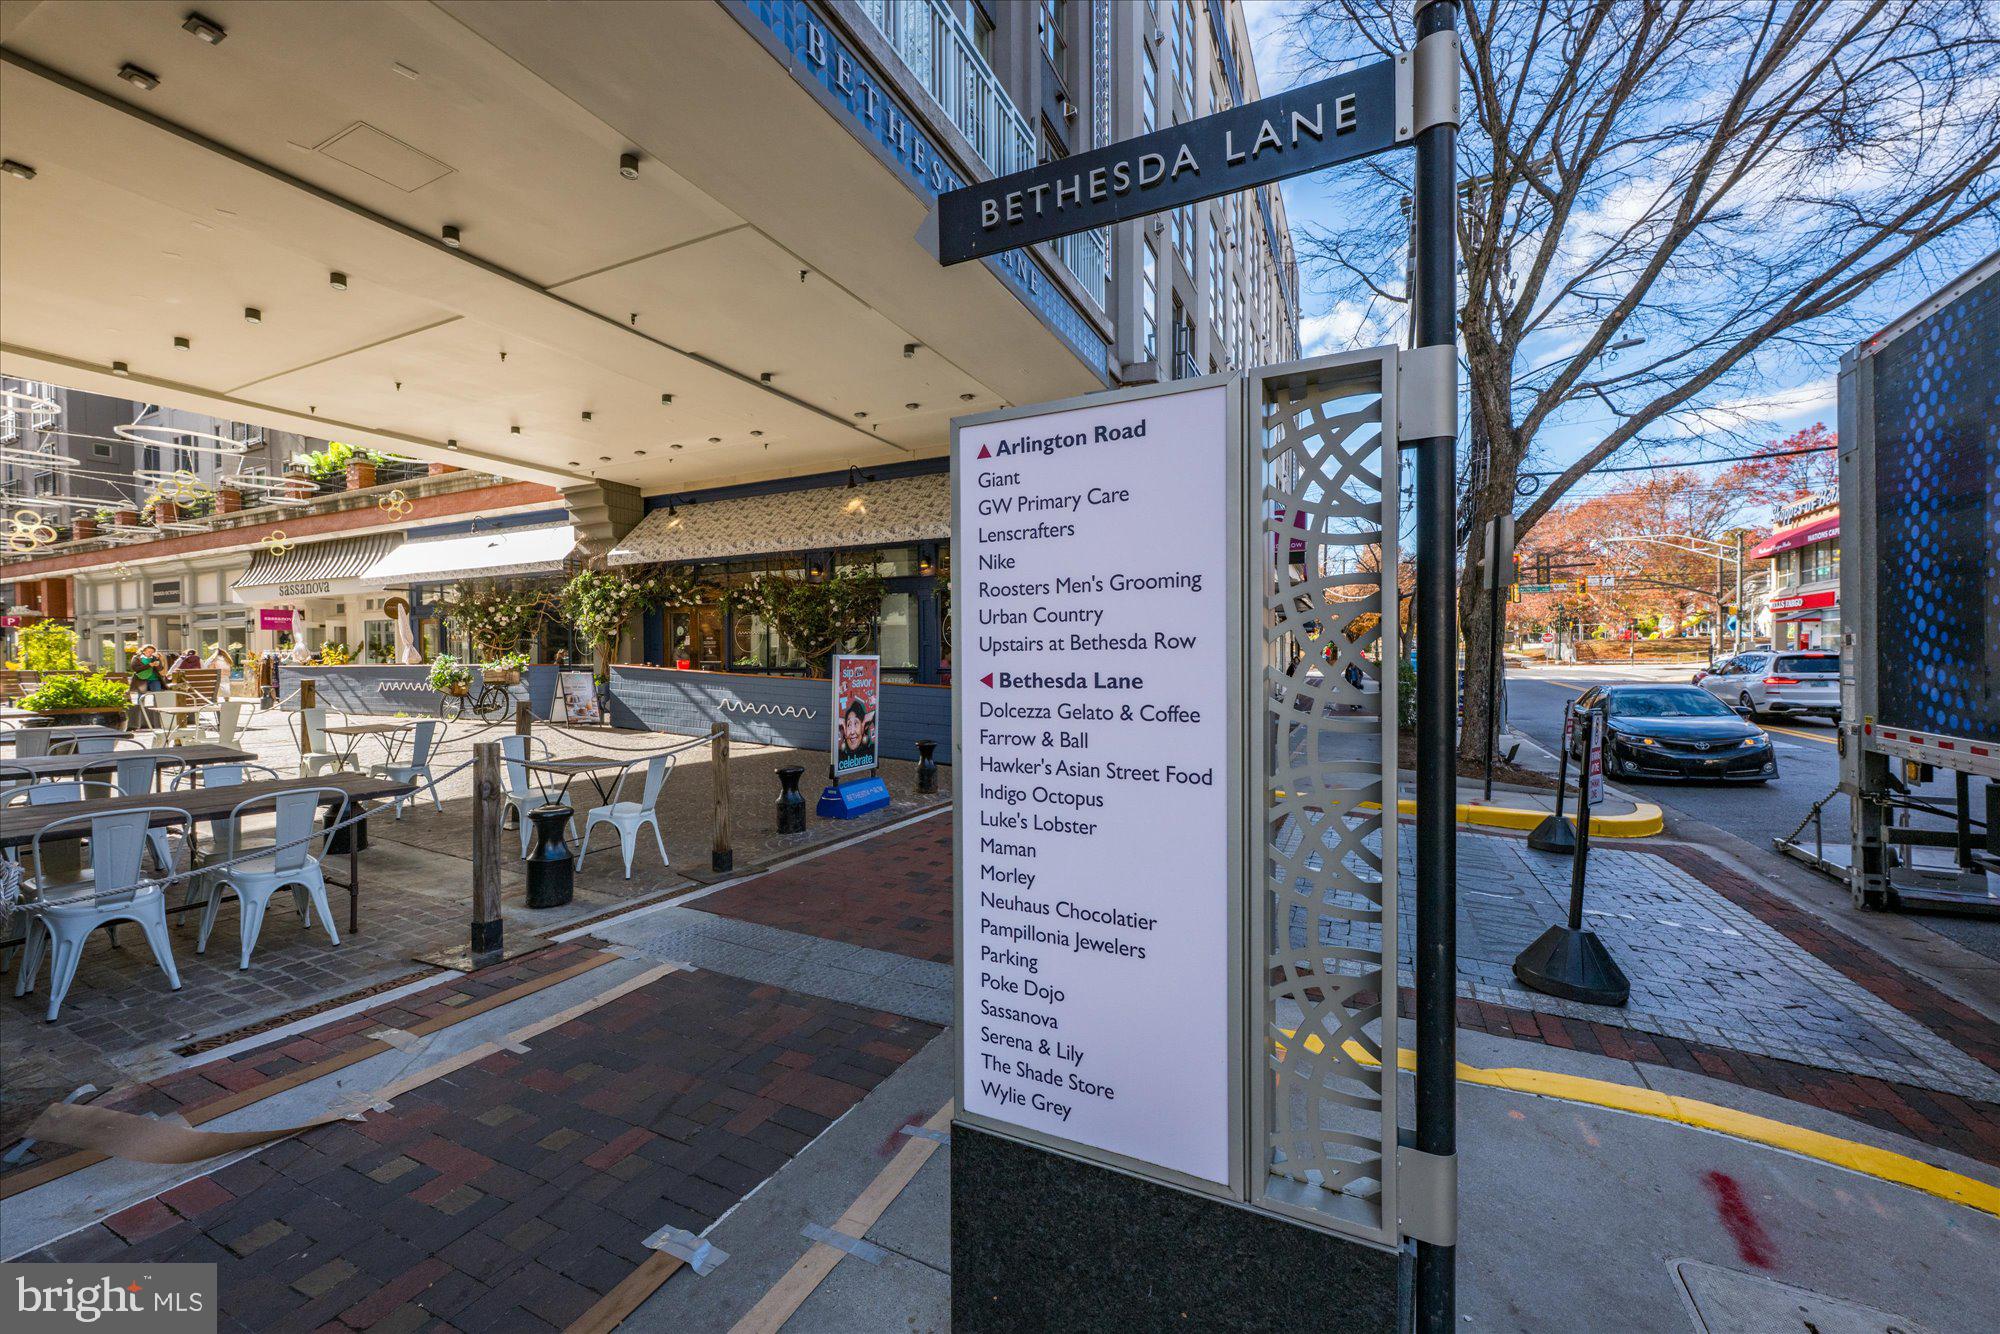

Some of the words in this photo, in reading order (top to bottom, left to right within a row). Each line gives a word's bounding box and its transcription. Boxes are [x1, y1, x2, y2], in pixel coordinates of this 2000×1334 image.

[980, 143, 1200, 230] BETHESDA
[1225, 92, 1357, 166] LANE
[1002, 250, 1039, 295] ANE
[995, 432, 1087, 457] Arlington
[1093, 418, 1146, 443] Road
[977, 471, 1020, 488] Giant
[977, 496, 1012, 515] GW
[1017, 494, 1081, 512] Primary
[1086, 487, 1129, 505] Care
[978, 521, 1074, 543] Lenscrafters
[978, 553, 1015, 570] Nike
[279, 581, 330, 596] sassanova
[978, 581, 1049, 597] Roosters
[1055, 574, 1103, 594] Men's
[1109, 571, 1202, 592] Grooming
[978, 608, 1027, 625] Urban
[1032, 606, 1103, 626] Country
[979, 635, 1043, 656] Upstairs
[1048, 637, 1065, 651] at
[1070, 632, 1148, 650] Bethesda
[1154, 631, 1196, 649] Row
[842, 667, 854, 680] sip
[851, 679, 873, 688] savor
[999, 671, 1088, 689] Bethesda
[1093, 671, 1143, 689] Lane
[979, 701, 1052, 719] Dolcezza
[1057, 702, 1113, 720] Gelato
[1119, 703, 1133, 721] &
[1139, 703, 1200, 723] Coffee
[979, 728, 1036, 746] Farrow
[1041, 730, 1054, 747] &
[1059, 730, 1088, 748] Ball
[838, 755, 873, 770] celebrate
[980, 755, 1052, 775] Hawker's
[1054, 759, 1100, 778] Asian
[1106, 761, 1160, 782] Street
[1165, 765, 1212, 786] Food
[980, 782, 1026, 805] Indigo
[1031, 785, 1103, 810] Octopus
[980, 809, 1027, 829] Luke's
[1033, 813, 1097, 835] Lobster
[980, 836, 1036, 858] Maman
[980, 863, 1035, 890] Morley
[980, 890, 1049, 915] Neuhaus
[1055, 900, 1157, 930] Chocolatier
[980, 917, 1070, 946] Pampillonia
[1072, 931, 1146, 959] Jewelers
[980, 944, 1038, 974] Parking
[980, 971, 1018, 993] Poke
[1023, 978, 1065, 1005] Dojo
[980, 998, 1059, 1029] Sassanova
[980, 1025, 1033, 1054] Serena
[1037, 1038, 1051, 1056] &
[1056, 1041, 1084, 1067] Lily
[981, 1053, 1011, 1075] The
[1016, 1061, 1063, 1087] Shade
[1068, 1073, 1115, 1100] Store
[981, 1080, 1026, 1106] Wylie
[1031, 1094, 1072, 1121] Grey
